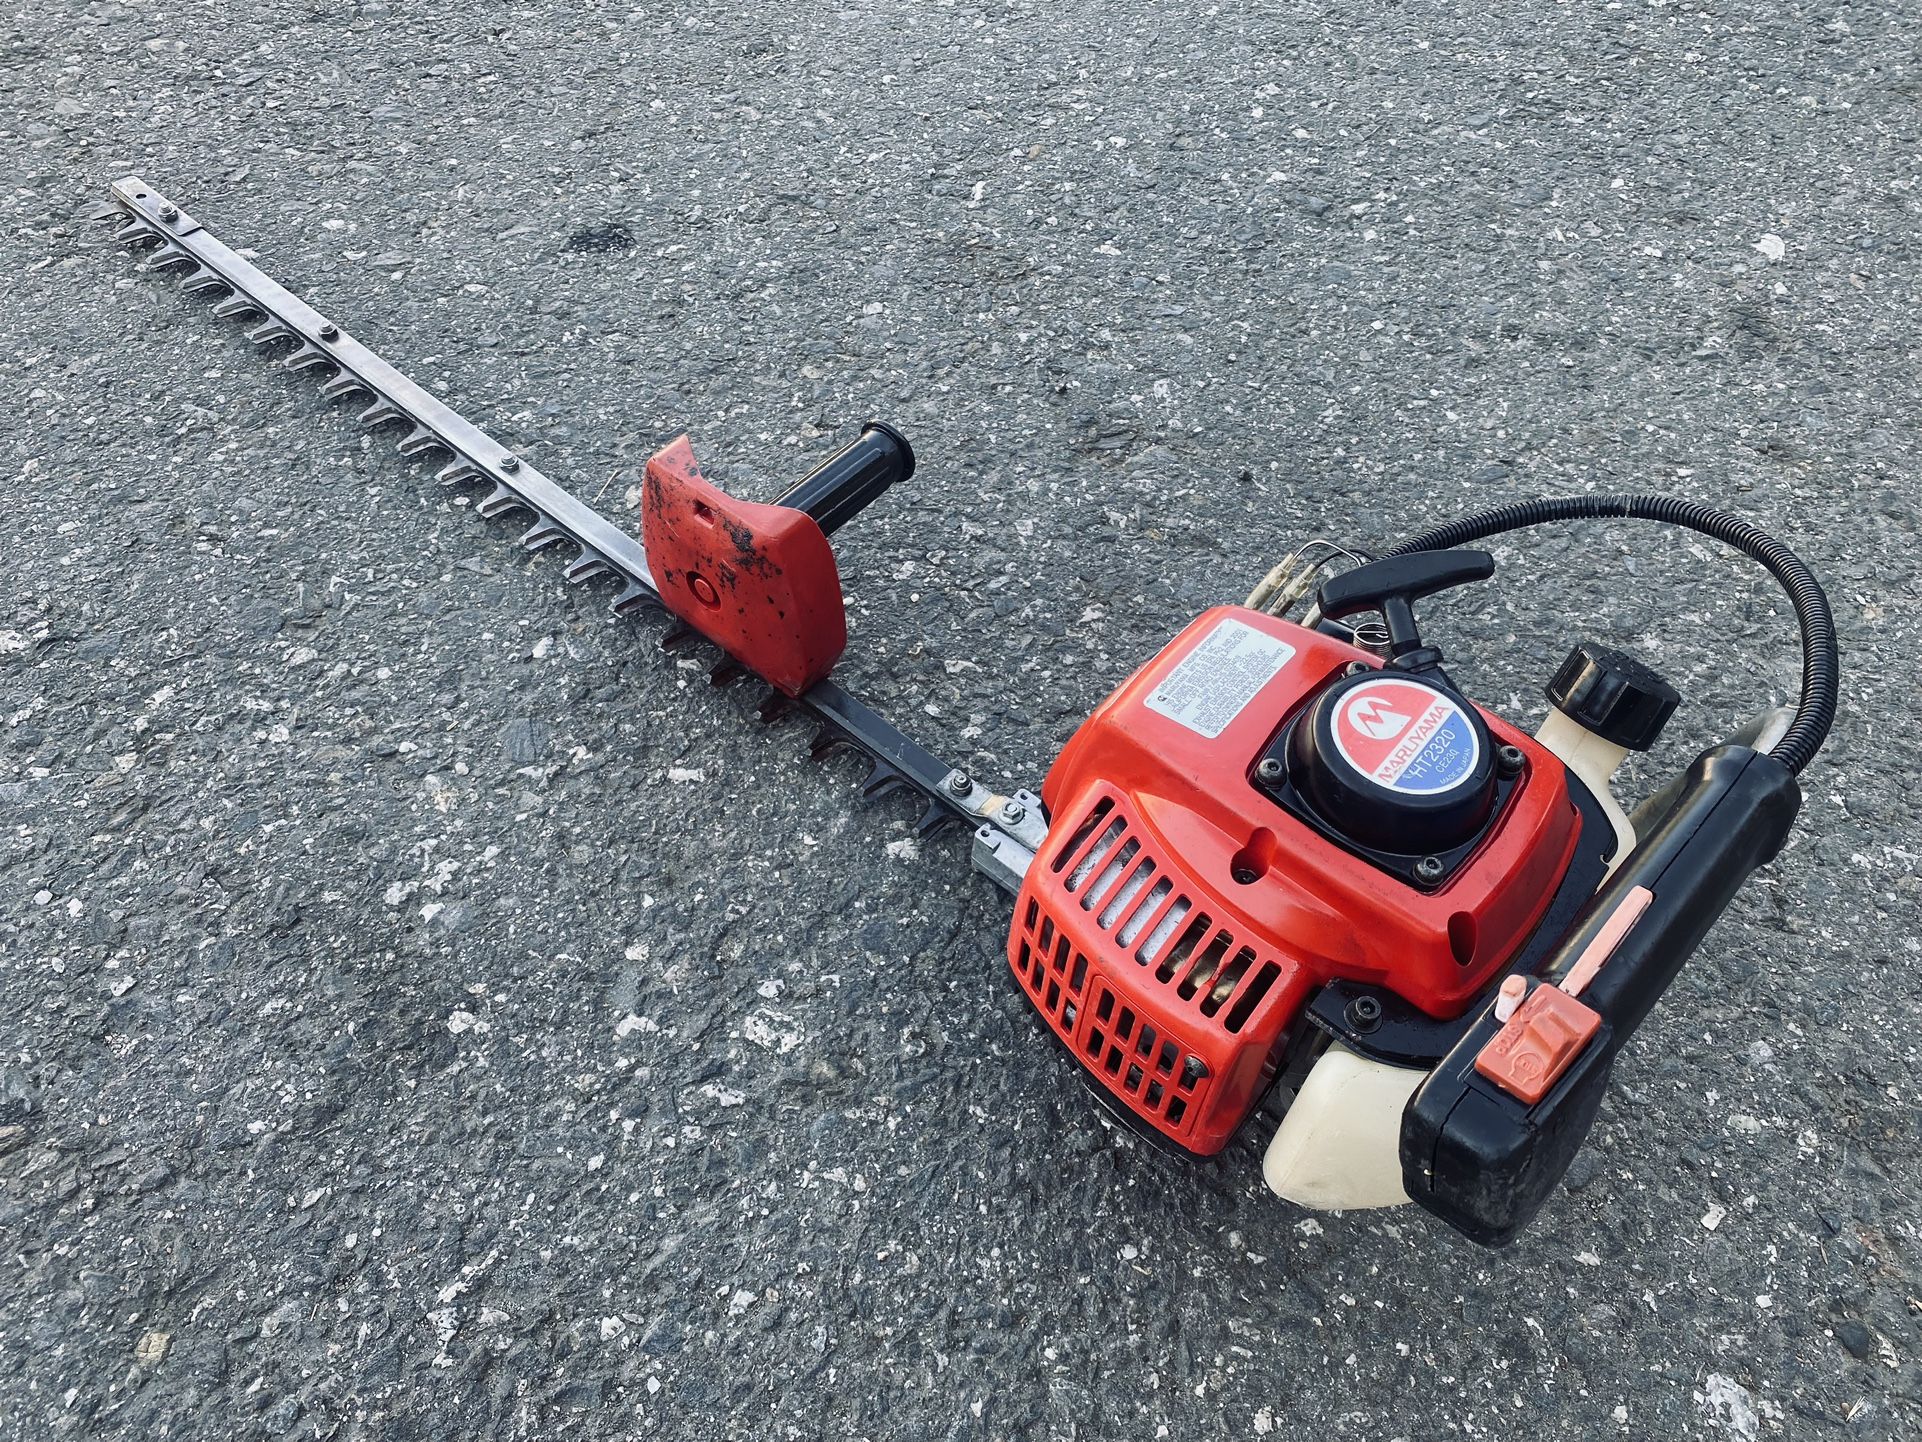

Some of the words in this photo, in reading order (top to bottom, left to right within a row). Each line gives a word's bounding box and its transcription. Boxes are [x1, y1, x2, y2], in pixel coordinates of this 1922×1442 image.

[1378, 705, 1449, 783] MARUYAMA
[1411, 728, 1456, 778] HT2320
[1440, 774, 1457, 785] MADE
[1461, 747, 1472, 769] JAPAN
